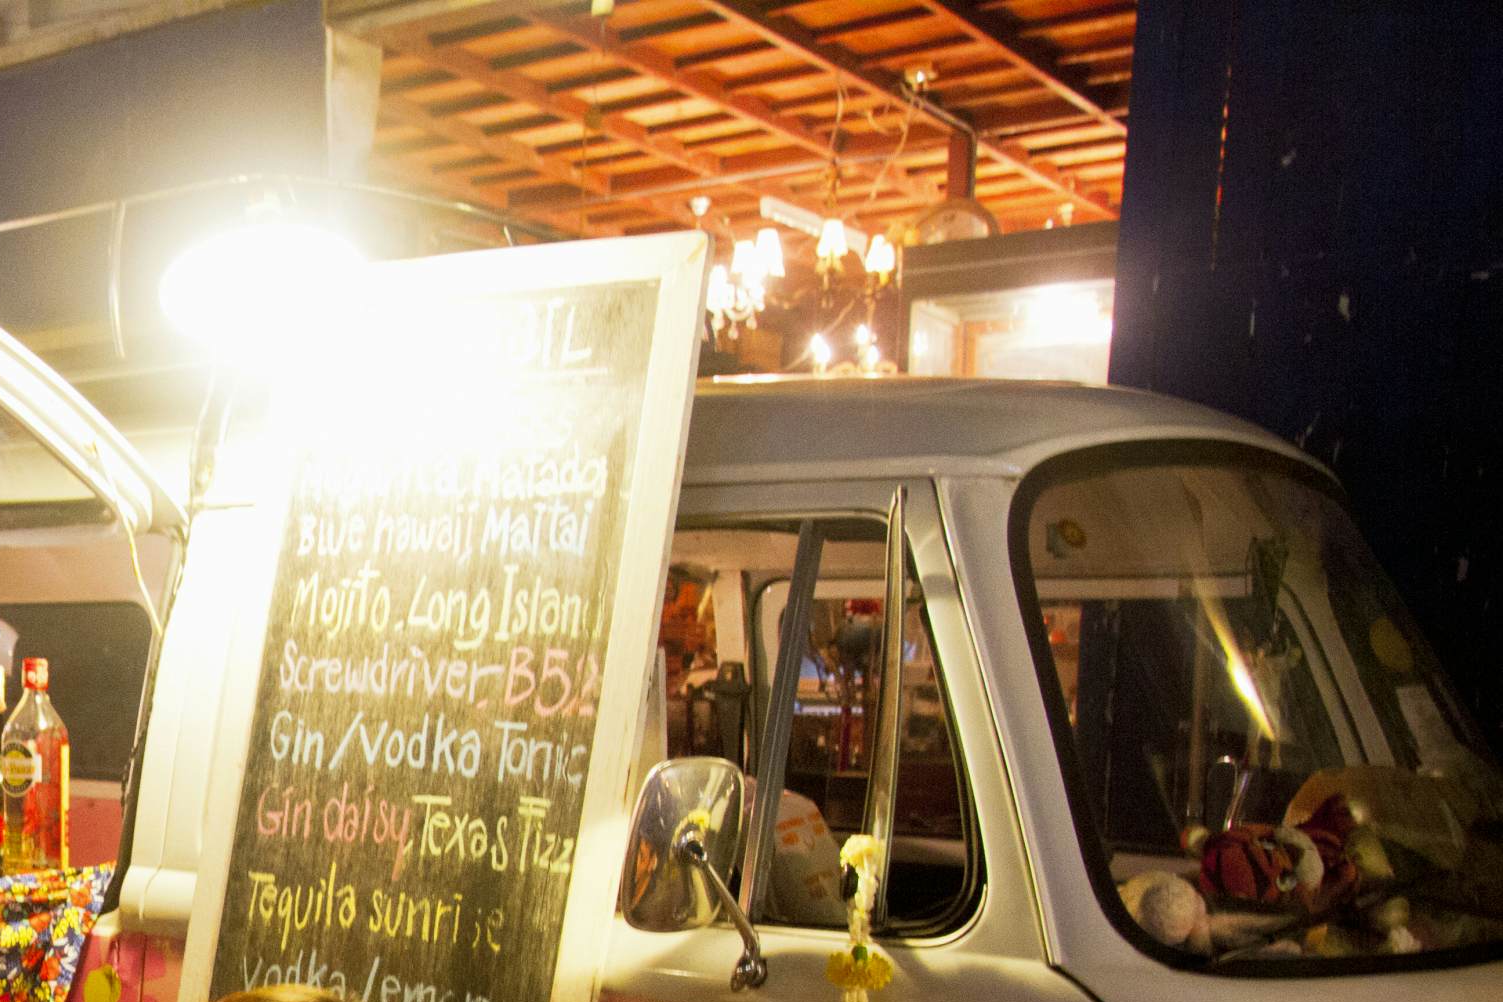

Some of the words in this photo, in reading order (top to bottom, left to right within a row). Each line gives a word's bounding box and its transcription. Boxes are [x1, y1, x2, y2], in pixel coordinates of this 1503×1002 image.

[407, 574, 492, 650] Long
[494, 719, 588, 789] Tonic
[257, 784, 313, 843] Gin
[412, 794, 509, 872] Texas
[247, 860, 357, 953] Tequila
